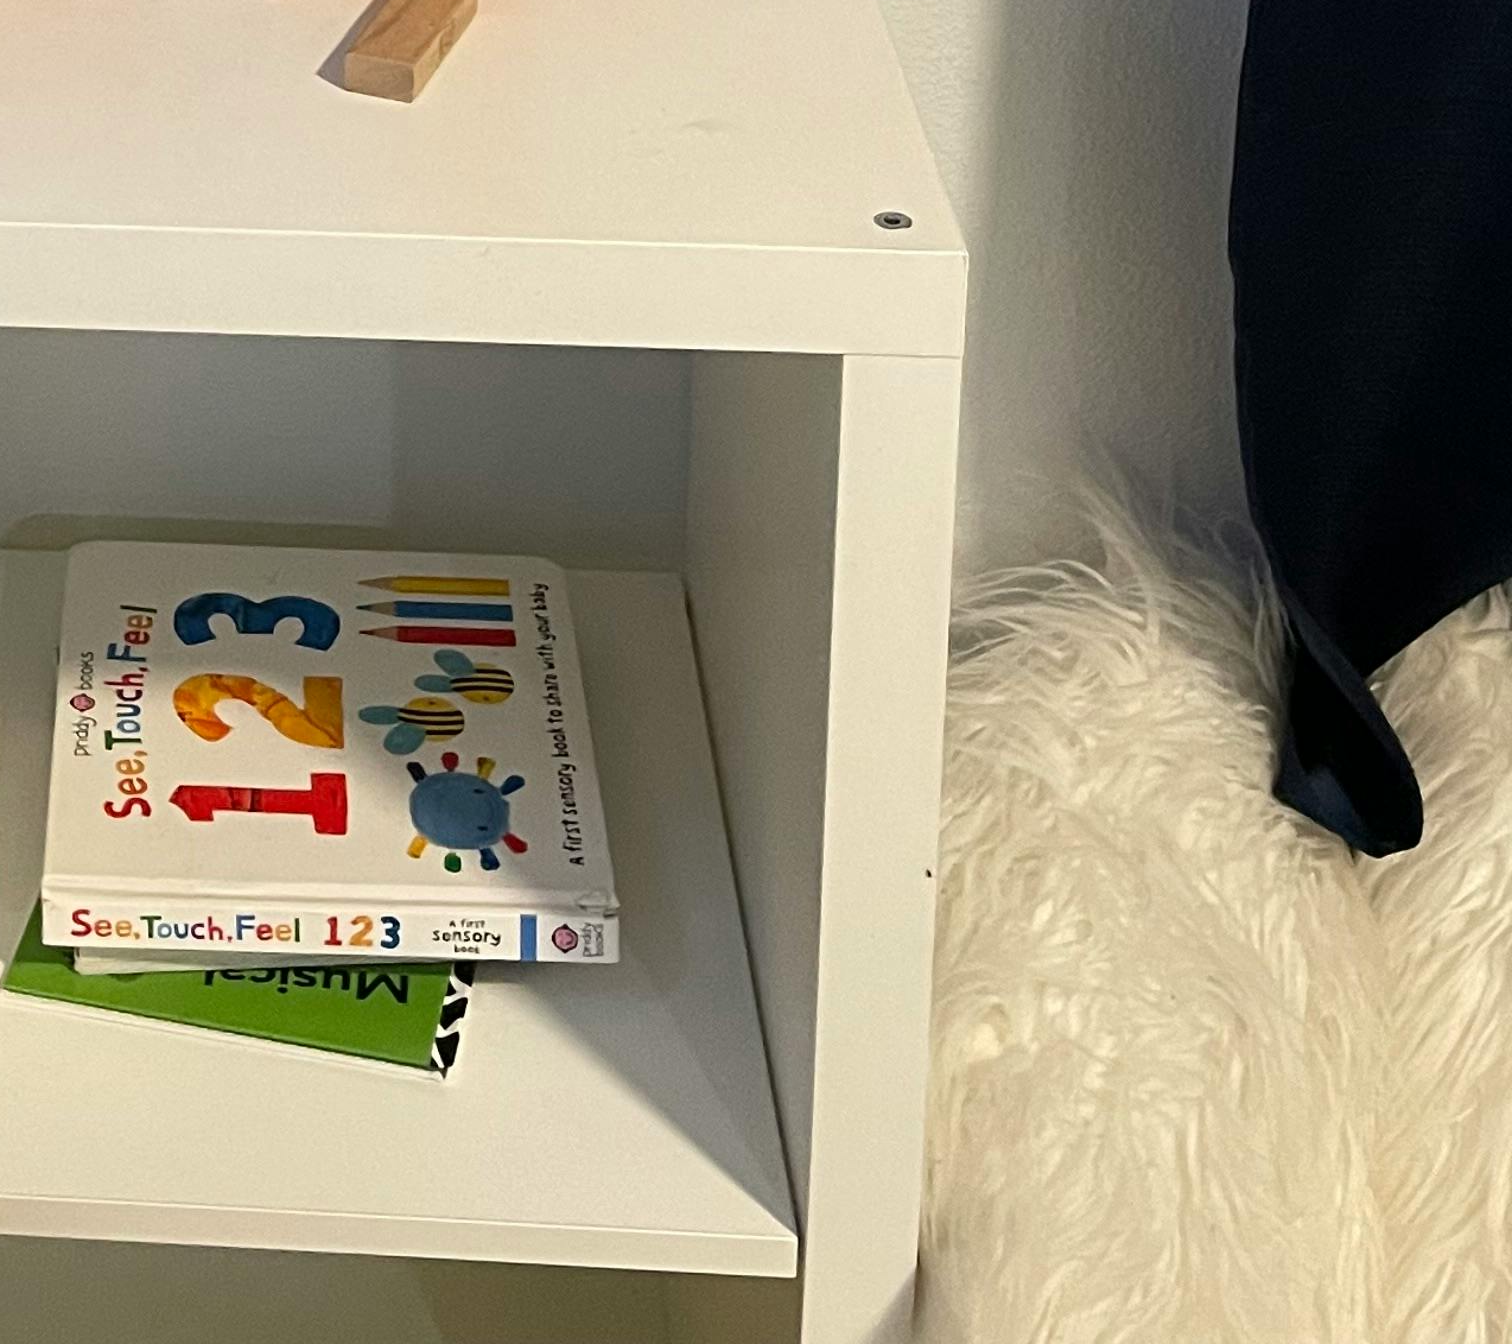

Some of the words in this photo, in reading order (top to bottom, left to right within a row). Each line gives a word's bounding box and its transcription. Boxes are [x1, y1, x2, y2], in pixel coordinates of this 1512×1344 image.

[530, 583, 550, 613] baby
[106, 605, 157, 662] Feel
[173, 592, 340, 651] 3
[535, 614, 556, 641] your
[81, 650, 95, 692] books
[535, 646, 556, 670] with
[543, 673, 563, 707] share
[173, 673, 345, 749] 2
[547, 709, 563, 724] to
[548, 728, 570, 758] book
[168, 773, 348, 835] 1
[558, 762, 577, 816] sensory
[562, 818, 583, 852] first
[236, 914, 300, 943] Feel
[324, 916, 343, 946] 1
[349, 915, 374, 947] 2
[380, 916, 401, 949] 3
[460, 918, 486, 929] first
